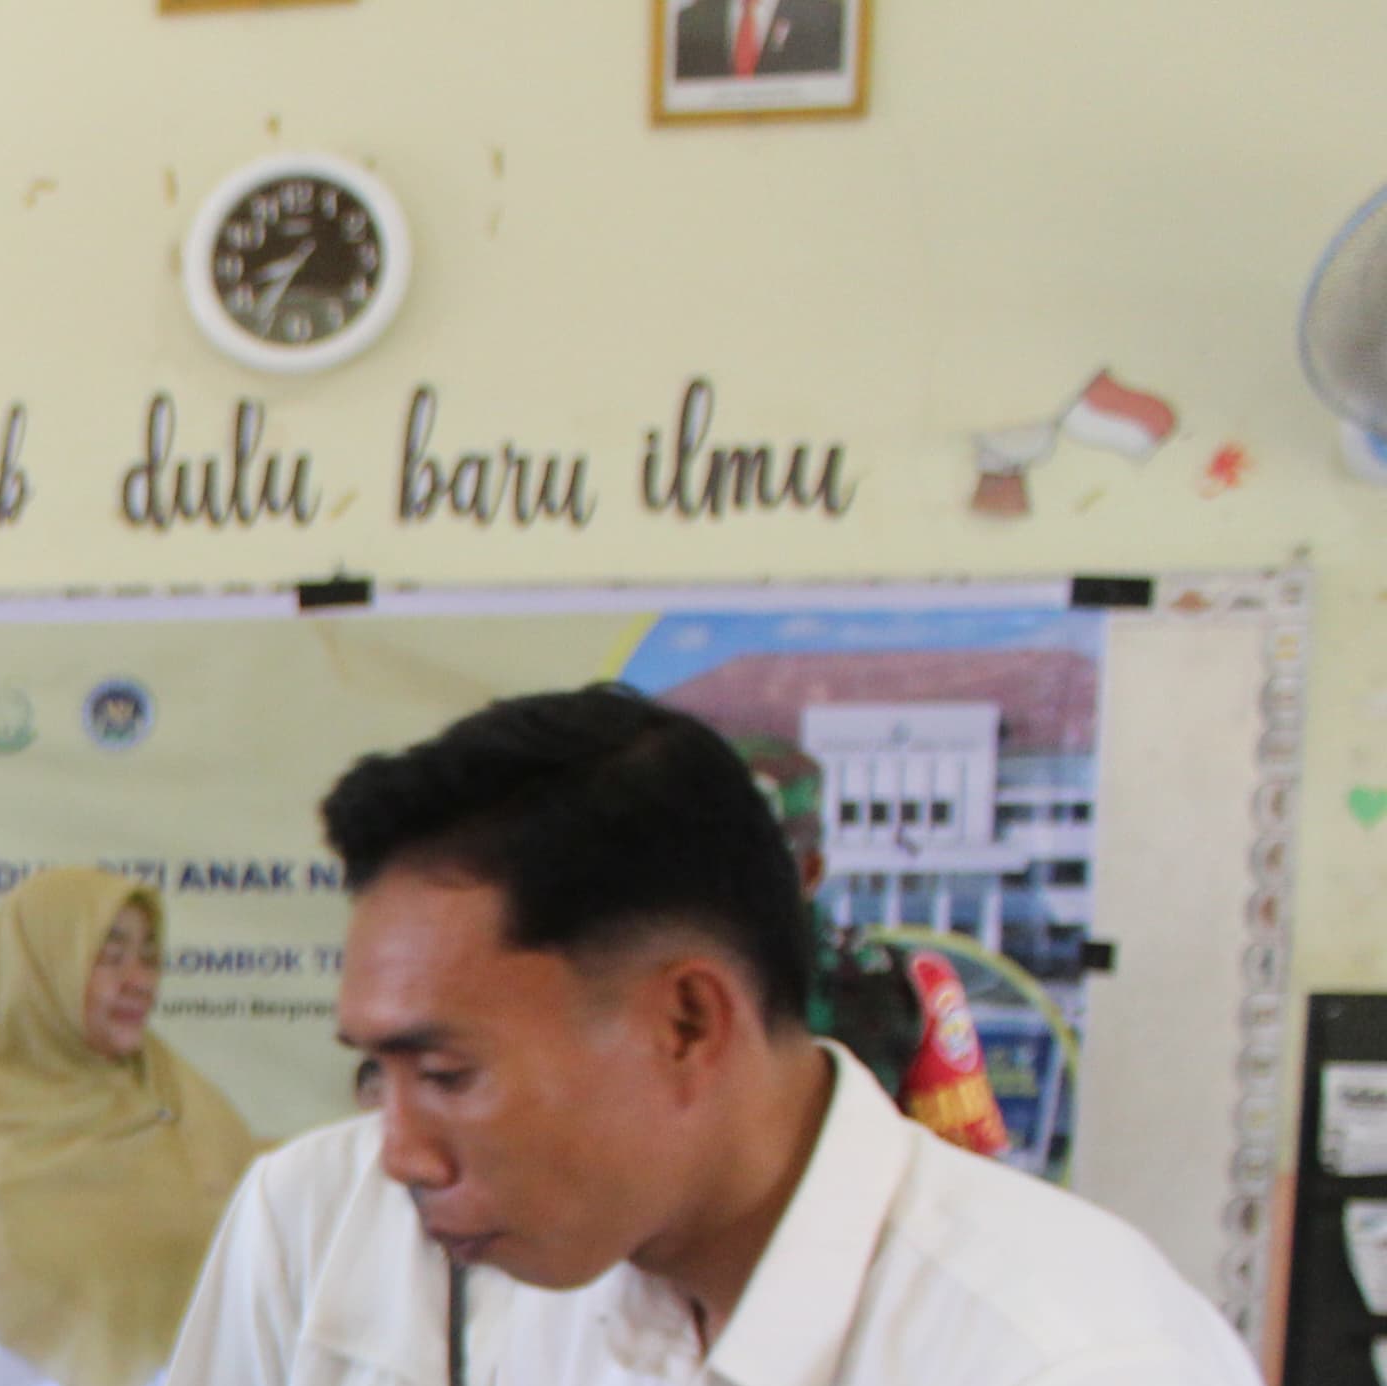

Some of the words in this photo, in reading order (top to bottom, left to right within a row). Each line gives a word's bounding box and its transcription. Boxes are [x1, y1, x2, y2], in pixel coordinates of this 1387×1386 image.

[123, 388, 322, 534] dulu
[395, 380, 597, 528] baru
[639, 372, 867, 522] ilmu
[178, 857, 297, 892] ANAK
